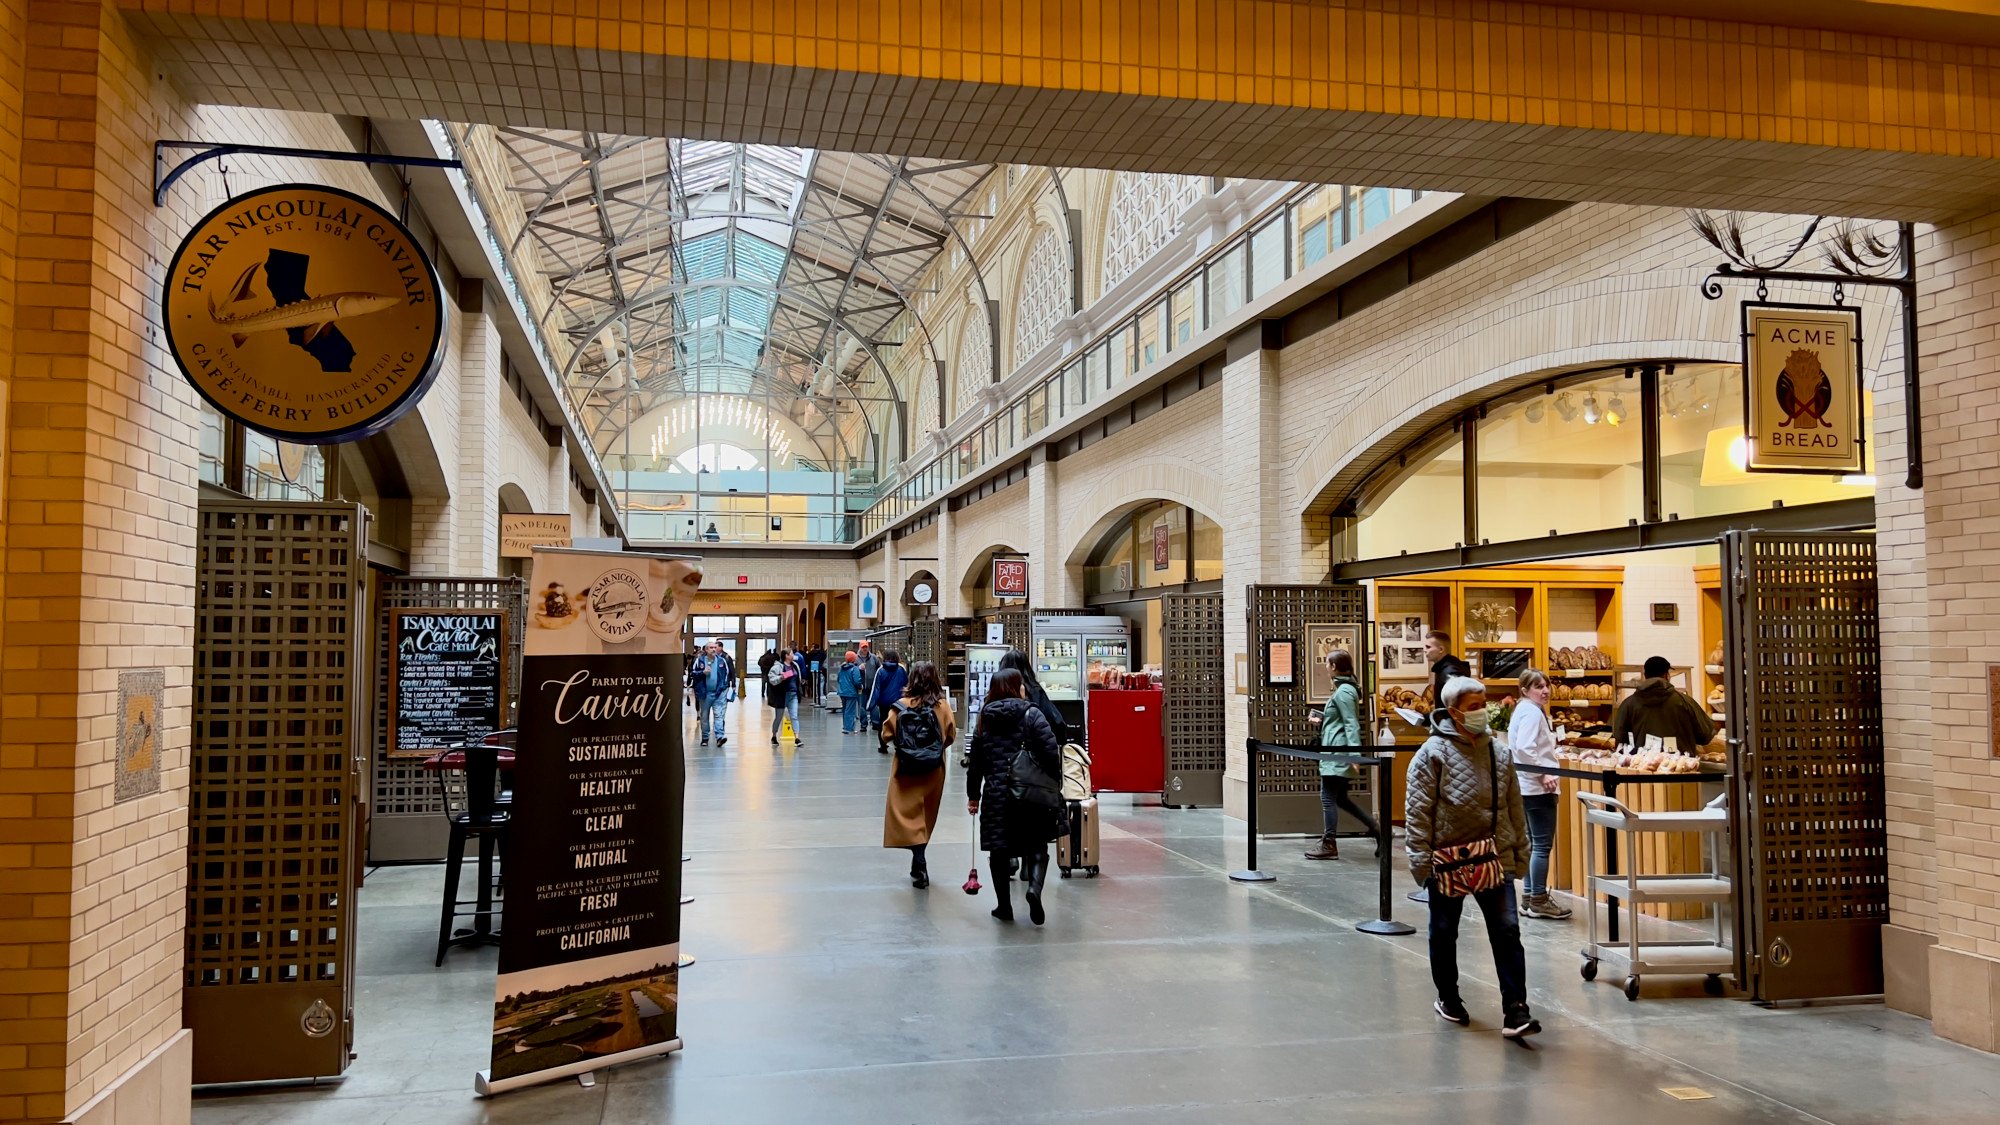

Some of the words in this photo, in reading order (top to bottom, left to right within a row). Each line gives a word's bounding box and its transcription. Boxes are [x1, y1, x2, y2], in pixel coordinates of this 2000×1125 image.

[263, 220, 302, 236] EST.
[314, 221, 353, 241] 1984
[182, 233, 229, 294] TSAR
[226, 199, 364, 237] NICOULAI
[366, 224, 425, 306] CAVIAR
[1771, 328, 1836, 346] ACME
[216, 347, 292, 401] SUSTAINABLE
[305, 352, 392, 403] HANDCRAFTED
[240, 393, 312, 421] FERRY
[328, 350, 415, 419] BUILDING
[1772, 432, 1838, 448] BREAD
[504, 521, 567, 533] DANDELION
[998, 563, 1024, 576] FATTED
[591, 576, 610, 598] TSAR
[611, 573, 646, 602] NICOULAI
[998, 576, 1022, 590] CALF
[402, 616, 435, 630] TSAR
[437, 616, 495, 630] NICOULAI
[600, 620, 634, 635] CAVIAR
[416, 626, 481, 651] Caviar
[452, 642, 473, 651] Menu
[592, 677, 618, 687] FARM
[621, 677, 634, 686] TO
[636, 676, 664, 686] TABLE
[541, 669, 671, 725] Caviar
[592, 734, 630, 742] PRACTICES
[568, 742, 647, 762] SUSTAINABLE
[589, 769, 628, 778] STURGEON
[580, 778, 632, 797] HEALTHY
[592, 804, 620, 814] WATERS
[585, 814, 623, 832] CLEAN
[589, 842, 606, 850] FISH
[608, 839, 626, 848] FEED
[575, 848, 628, 870] NATURAL
[536, 884, 552, 892] OUR
[556, 880, 584, 890] CAVIAR
[596, 876, 621, 884] CURED
[624, 872, 642, 880] WITH
[644, 870, 660, 878] FINE
[537, 890, 566, 900] PACIFIC
[632, 878, 658, 886] ALWAYS
[580, 892, 618, 912] FRESH
[536, 924, 572, 936] PROUDLY
[574, 920, 602, 931] GROWN
[612, 914, 644, 924] CRAFTED
[560, 924, 630, 951] CALIFORNIA
